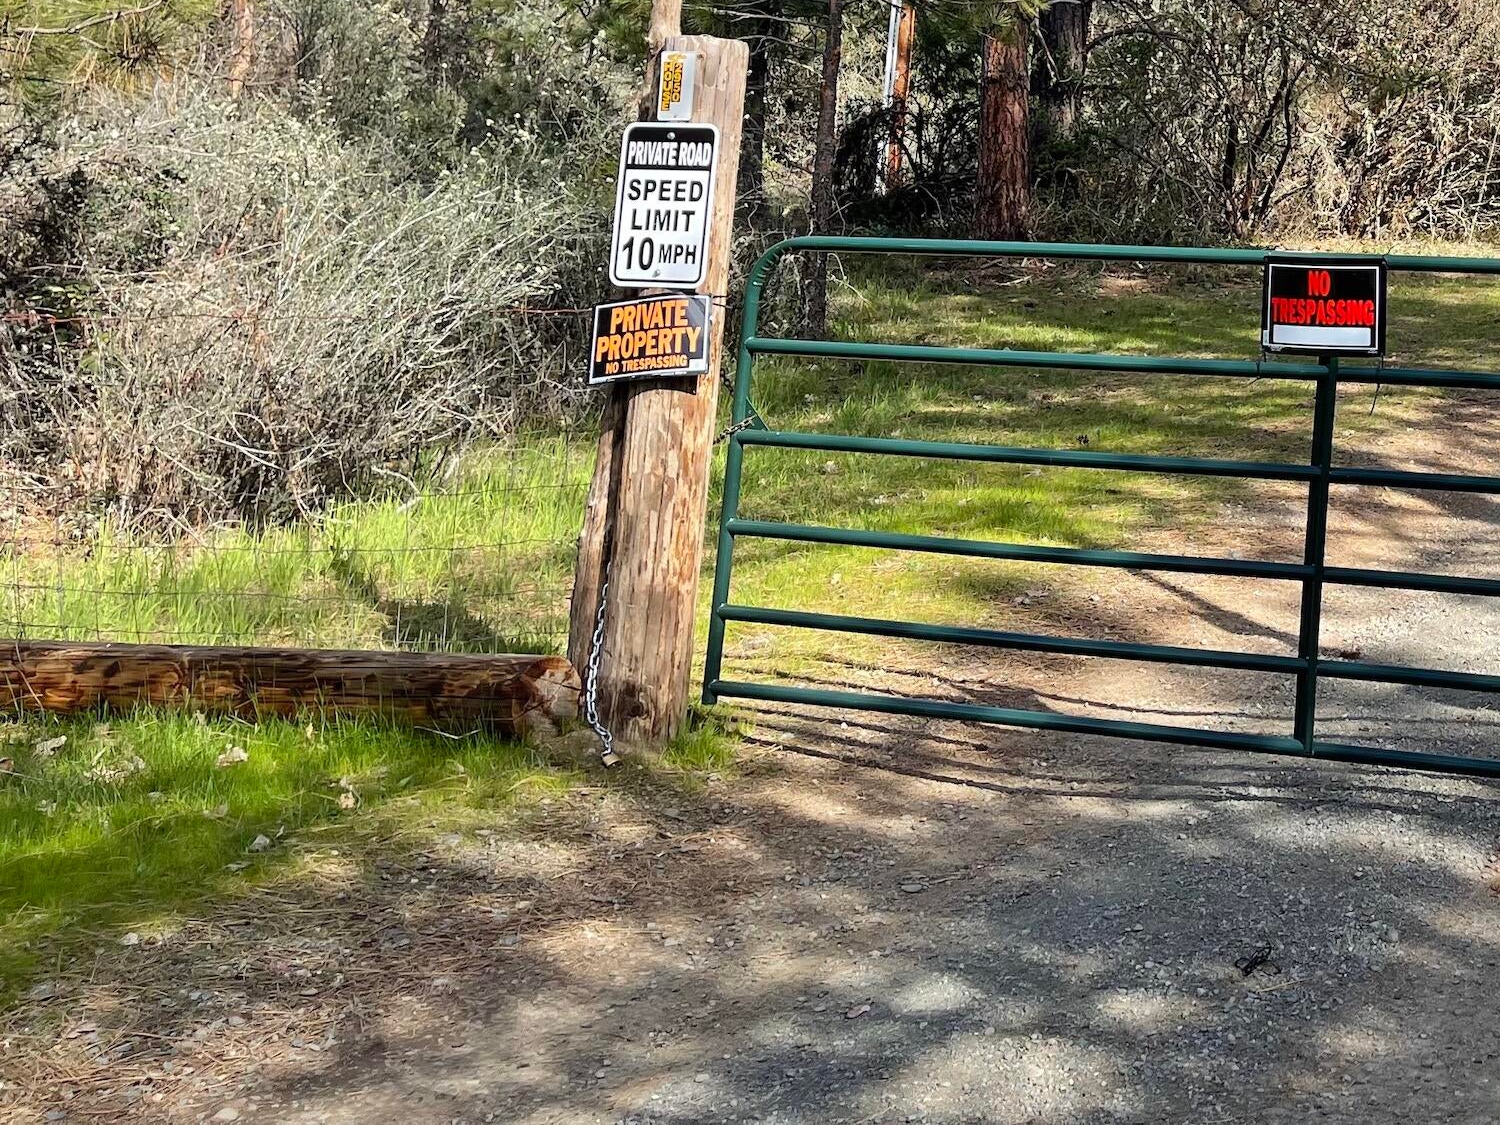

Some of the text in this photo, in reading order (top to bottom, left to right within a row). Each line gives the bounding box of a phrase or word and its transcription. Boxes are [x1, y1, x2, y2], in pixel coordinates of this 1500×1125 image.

[661, 62, 673, 111] HOUSE
[671, 62, 683, 102] 2950
[627, 141, 712, 166] PRIVATE ROAD
[627, 178, 703, 202] SPEED
[631, 208, 695, 232] LIMIT
[622, 236, 697, 270] 10 MPH
[1308, 270, 1331, 296] NO
[610, 300, 689, 334] PRIVATE
[1272, 297, 1374, 326] TRESPASSING
[596, 326, 701, 362] PROPERTY
[605, 354, 688, 374] NO TRESPASSING
